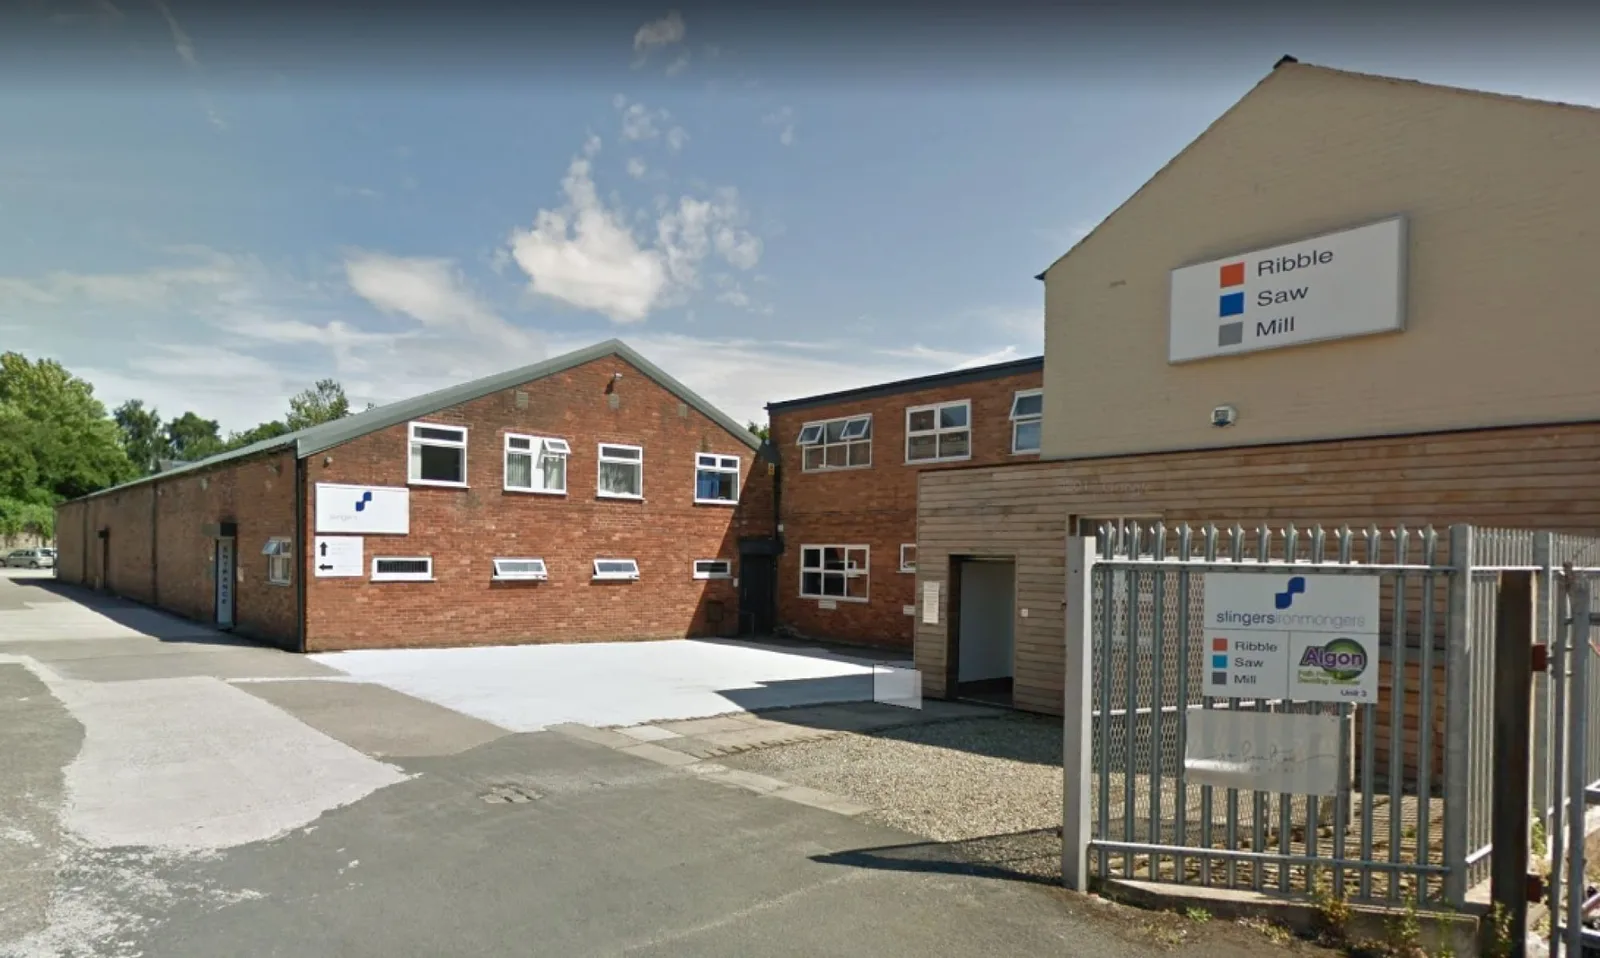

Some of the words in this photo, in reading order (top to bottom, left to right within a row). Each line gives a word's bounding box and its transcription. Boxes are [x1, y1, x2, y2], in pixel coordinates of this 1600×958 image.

[1257, 250, 1334, 277] Ribble
[1257, 286, 1309, 307] Saw
[1256, 316, 1296, 337] Mill
[1234, 640, 1278, 653] Ribble
[1234, 657, 1264, 668] Saw
[1304, 647, 1364, 668] Algon
[1234, 673, 1257, 685] Mill
